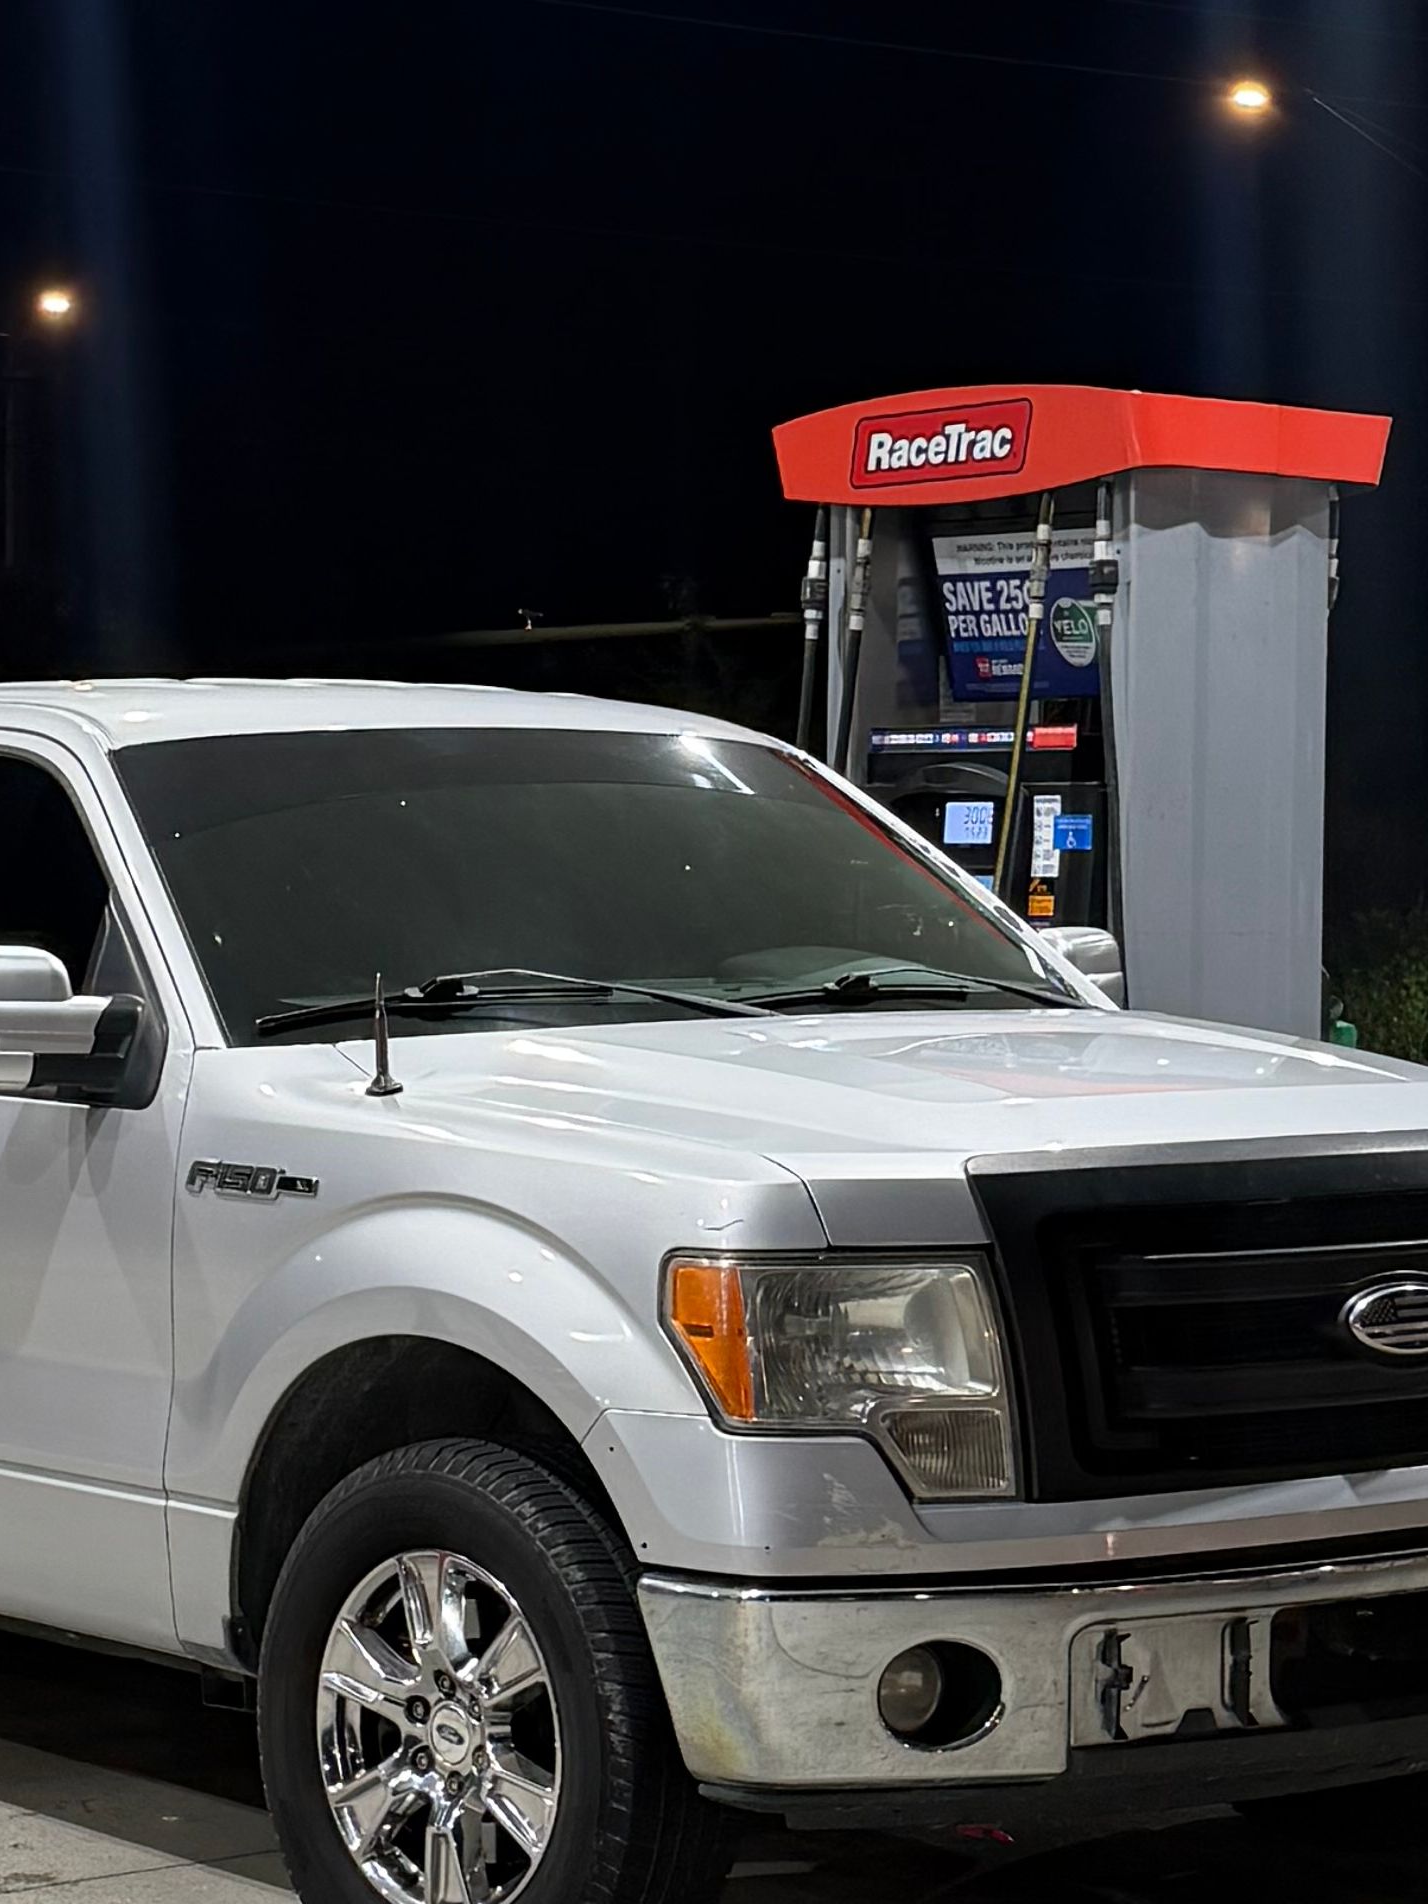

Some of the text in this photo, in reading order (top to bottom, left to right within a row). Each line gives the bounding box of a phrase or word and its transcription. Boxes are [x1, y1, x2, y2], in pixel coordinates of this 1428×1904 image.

[867, 423, 1013, 472] RaceTrac
[942, 581, 995, 612] SAVE
[948, 612, 1031, 638] PER GALLO
